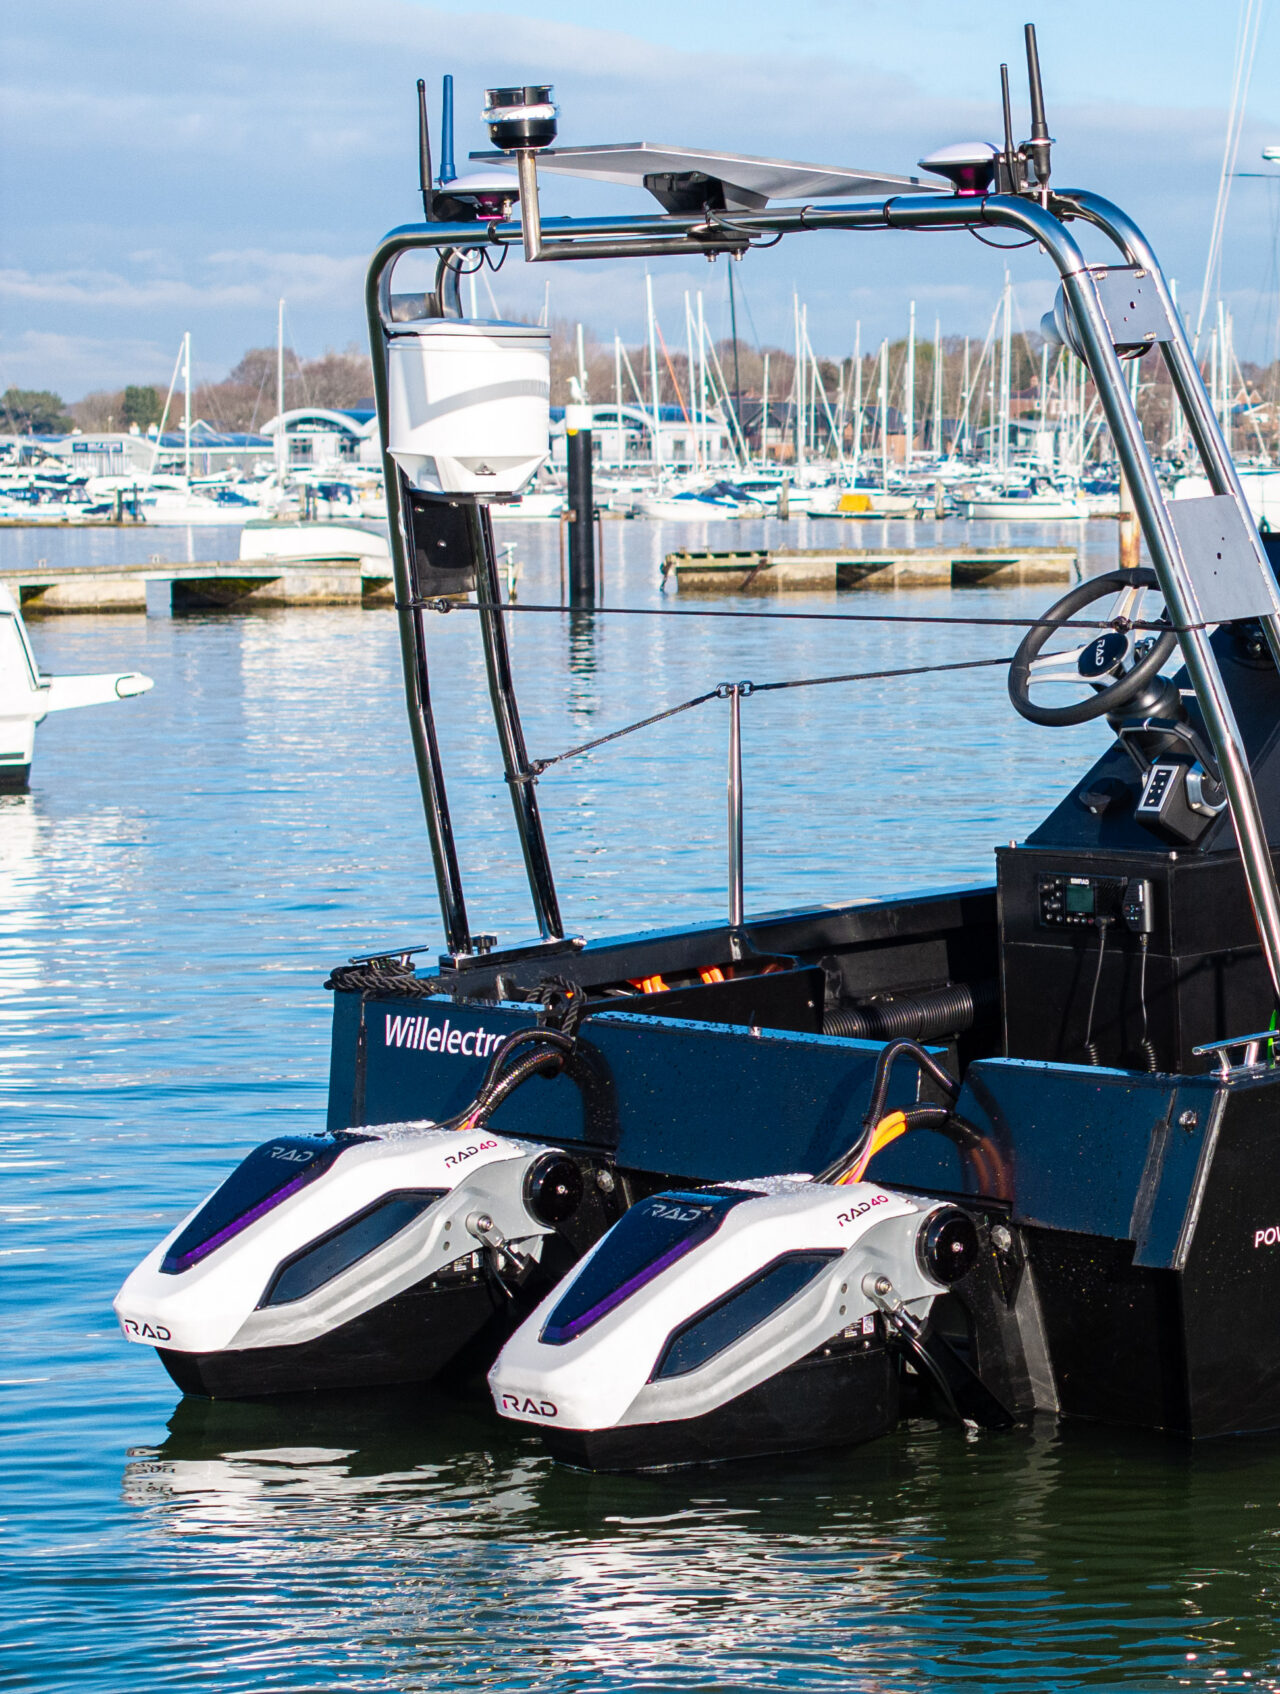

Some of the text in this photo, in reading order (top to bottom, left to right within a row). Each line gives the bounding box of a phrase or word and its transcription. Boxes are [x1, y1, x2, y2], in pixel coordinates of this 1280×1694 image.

[1095, 639, 1105, 666] RAD
[264, 1146, 314, 1162] RAD
[641, 1203, 702, 1221] RAD
[124, 1319, 172, 1342] RAD
[502, 1393, 559, 1418] RAD
